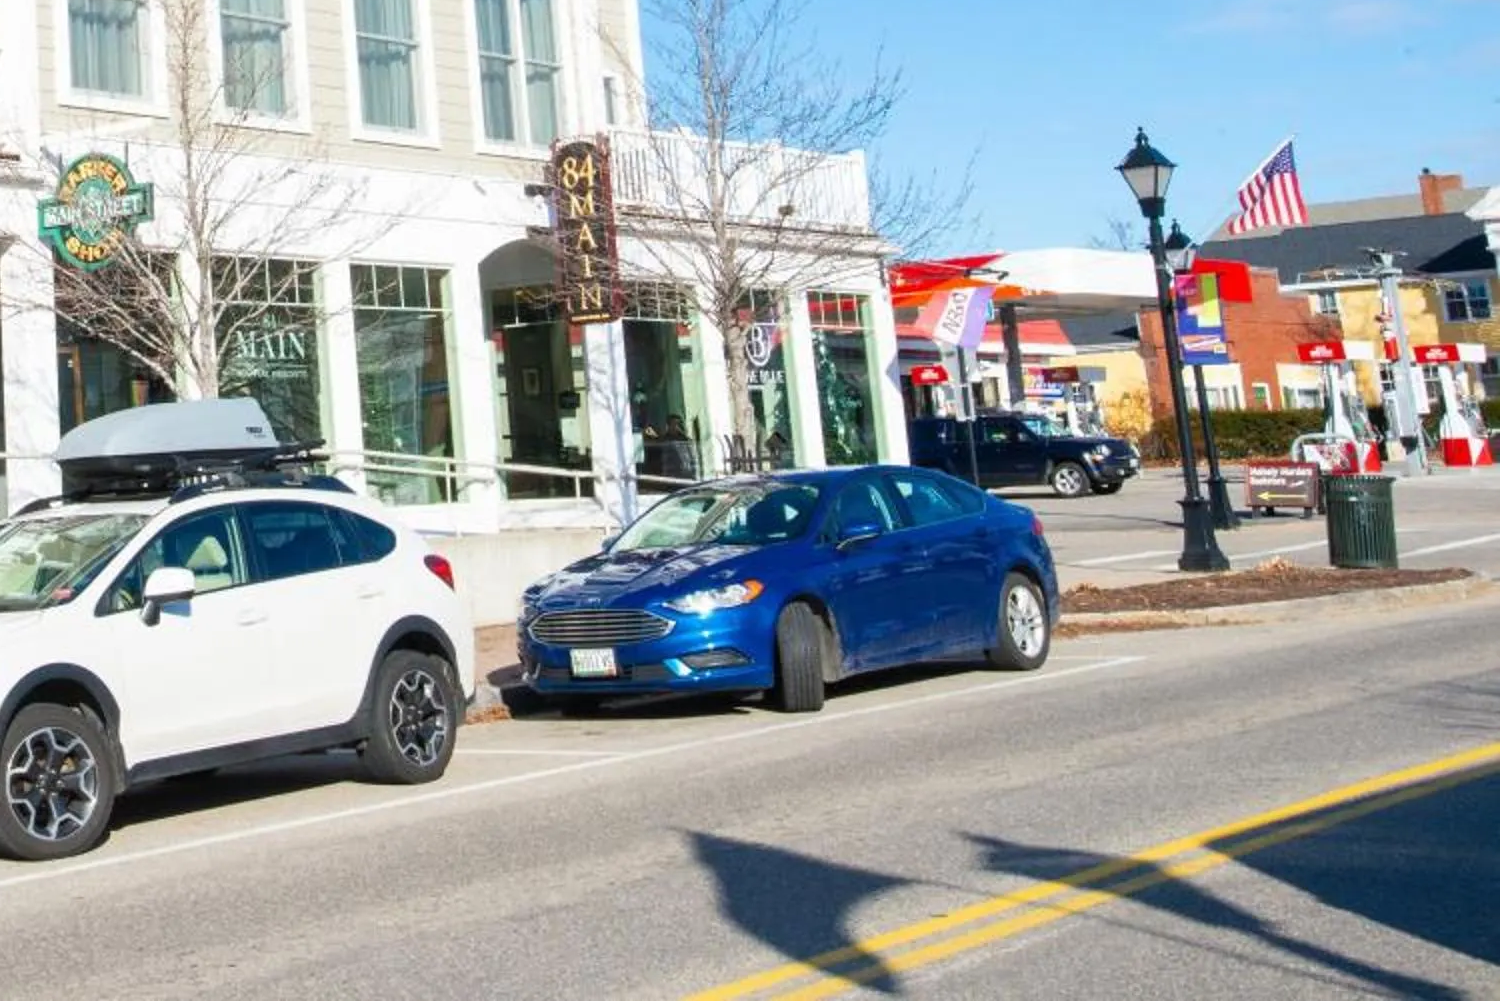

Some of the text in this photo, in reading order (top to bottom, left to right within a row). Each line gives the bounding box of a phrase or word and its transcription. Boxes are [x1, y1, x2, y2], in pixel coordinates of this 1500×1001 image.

[562, 154, 596, 190] 84
[569, 190, 602, 310] MAIN
[235, 330, 305, 360] MAIN
